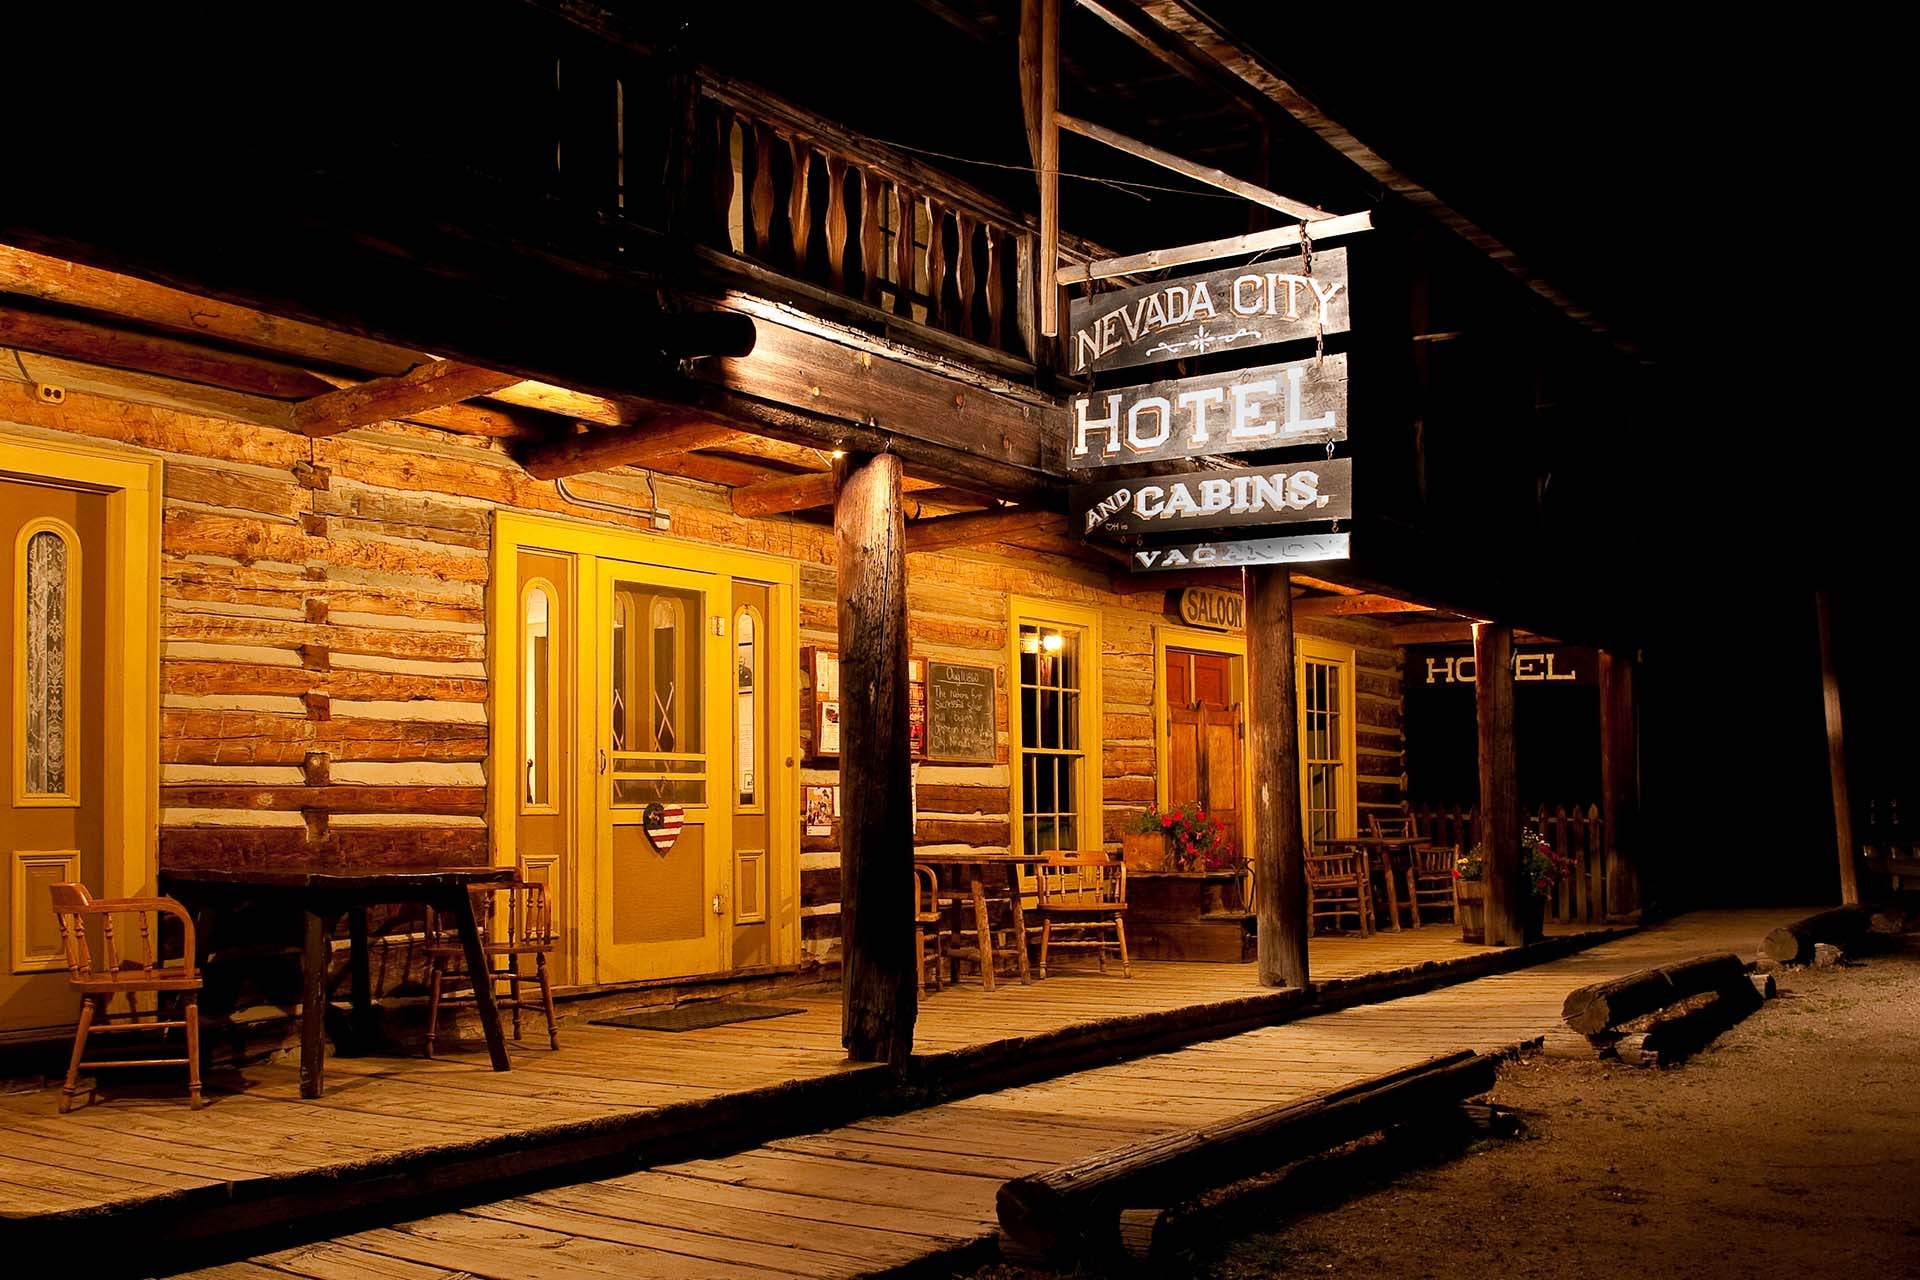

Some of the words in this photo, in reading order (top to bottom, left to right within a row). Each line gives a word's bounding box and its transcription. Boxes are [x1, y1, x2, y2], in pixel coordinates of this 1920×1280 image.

[1072, 281, 1217, 375] NEVADA
[1230, 272, 1345, 327] CITY
[1071, 366, 1336, 459] HOTEL
[1085, 488, 1131, 534] AND
[1187, 589, 1242, 628] SALOON
[1426, 653, 1576, 683] HOEL
